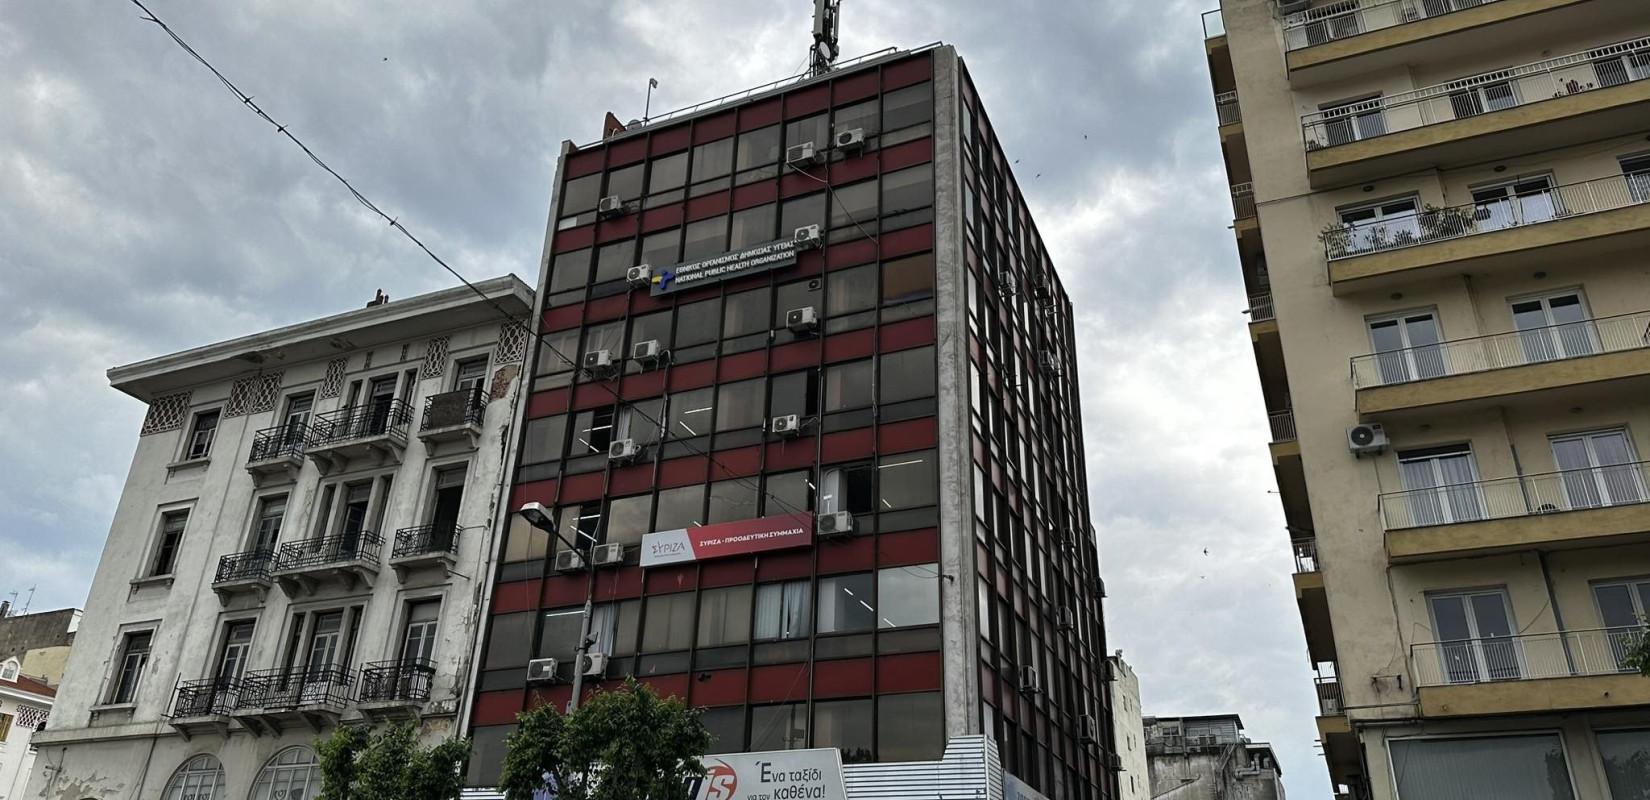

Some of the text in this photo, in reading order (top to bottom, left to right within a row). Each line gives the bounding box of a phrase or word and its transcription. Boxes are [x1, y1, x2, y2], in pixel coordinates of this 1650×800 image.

[674, 250, 795, 284] NATIONAL PUBLIC HEALTH ORGANIZATION
[675, 240, 795, 274] ΕΘΝΙΚΟΣ ΟΡΓΑΝΙΣΜΟΣ ΔΗΜΟΣΙΑΣ ΥΓΕΙΑΣ
[699, 538, 721, 547] ΣΥΡΙΖΑ
[725, 532, 769, 544] ΠΡΟΟΔΕΥΤΙΚΗ
[769, 528, 804, 538] ΣΥΜΜΑΧΙΑ
[755, 761, 822, 783] Ένα ταξίδι
[773, 784, 826, 800] καθένα!
